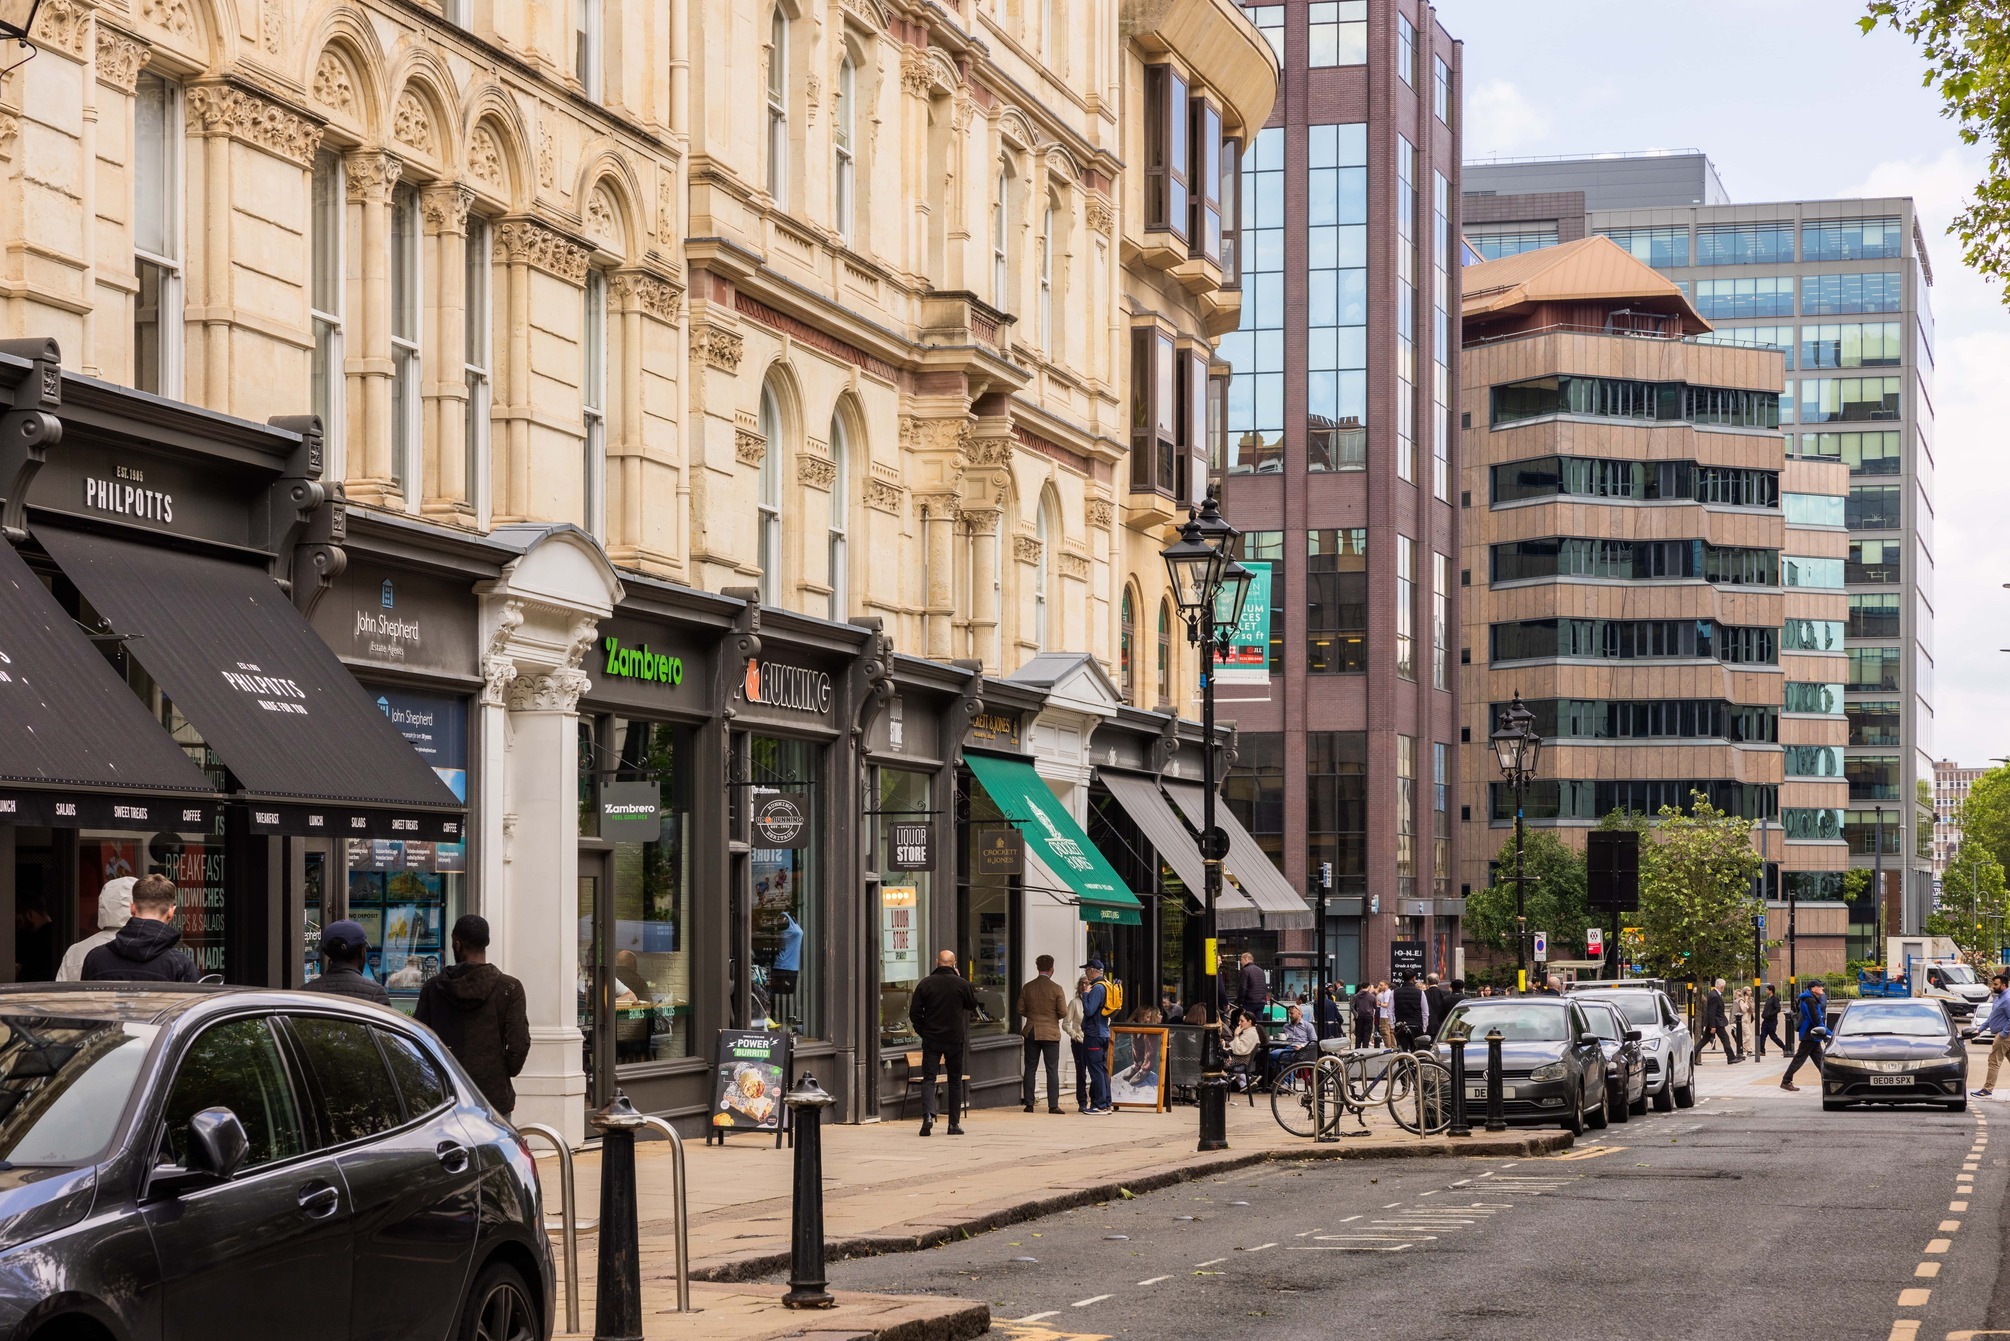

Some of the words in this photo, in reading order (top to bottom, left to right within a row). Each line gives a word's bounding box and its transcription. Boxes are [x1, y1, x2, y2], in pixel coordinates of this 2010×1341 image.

[86, 477, 173, 523] PHILPOTTS
[356, 610, 377, 635] John
[379, 614, 419, 642] Shepherd
[371, 641, 387, 653] Estate
[388, 644, 404, 657] Agents
[605, 636, 683, 686] Zambrero
[221, 671, 306, 699] PHILPOTTS
[258, 700, 281, 712] MADE
[276, 702, 295, 713] FOR
[290, 703, 308, 715] YOU
[391, 708, 405, 723] John
[406, 709, 433, 728] Shepherd
[56, 802, 76, 816] SALADS
[114, 805, 130, 819] SWEET
[131, 807, 148, 820] TREATS
[182, 809, 202, 822] COFFEE
[604, 804, 655, 813] Zambrero
[255, 812, 280, 825] BREAKFAST
[309, 815, 323, 826] LUNCH
[351, 816, 366, 828] SALADS
[392, 819, 405, 830] SWEET
[405, 820, 418, 831] TREATS
[443, 822, 458, 833] COFFEE
[766, 830, 794, 841] HERITAGE
[897, 829, 926, 847] LIQUOR
[897, 846, 926, 862] STORE
[1048, 841, 1085, 858] CROCKETT
[165, 853, 225, 881] BREAKFAST
[192, 913, 198, 931] &
[199, 914, 225, 931] SALADS
[196, 946, 225, 970] MADE
[737, 1039, 769, 1048] POWER
[736, 1049, 769, 1057] BURRITO
